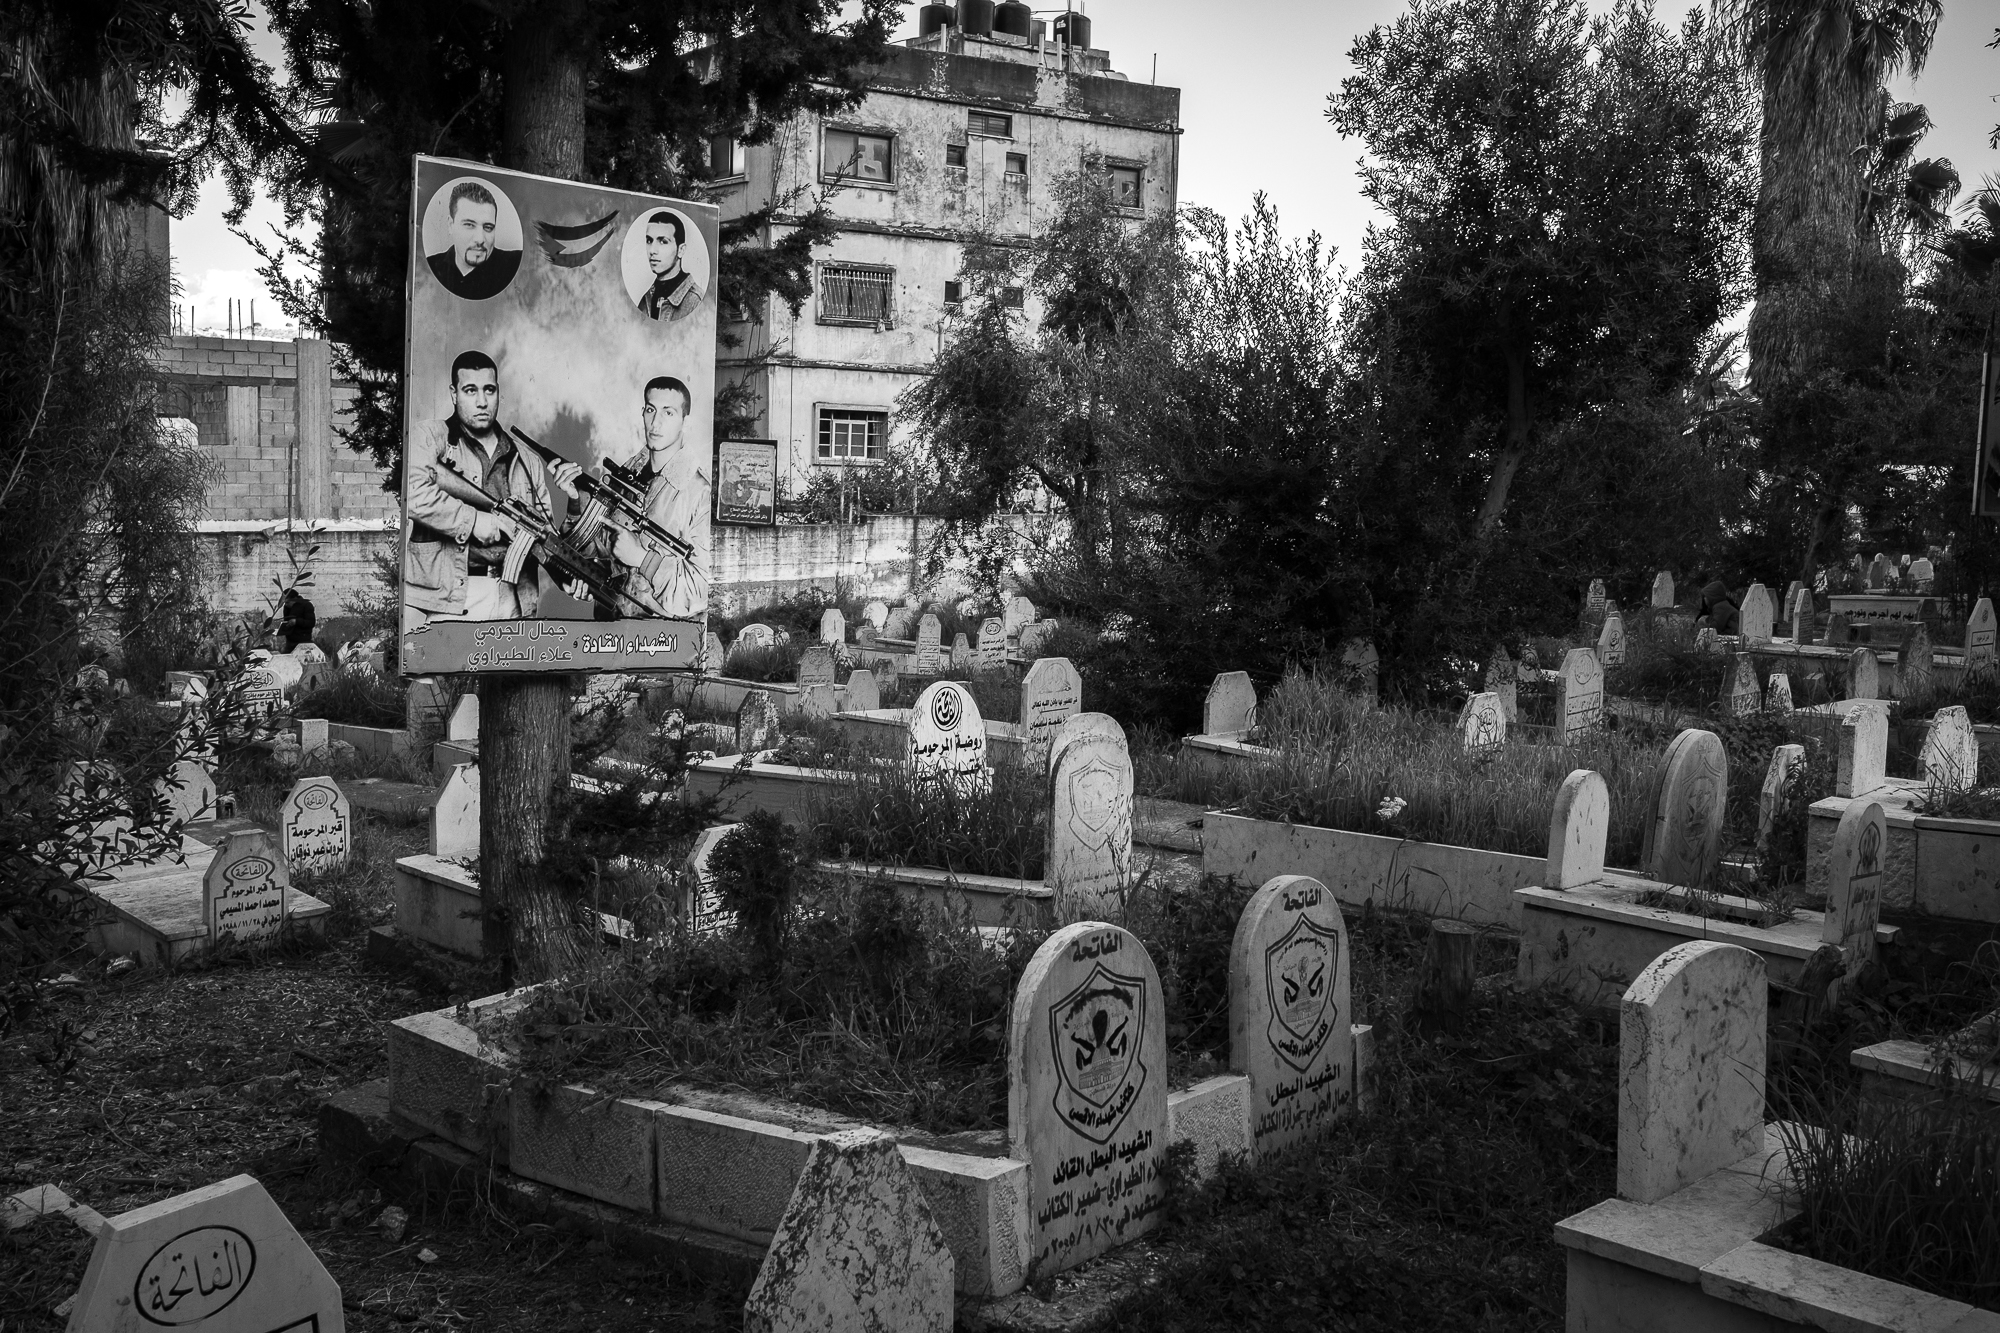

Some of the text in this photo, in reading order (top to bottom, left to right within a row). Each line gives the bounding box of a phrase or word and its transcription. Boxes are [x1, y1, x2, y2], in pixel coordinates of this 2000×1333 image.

[474, 621, 568, 647] جمال الجرمي
[581, 633, 625, 654] القادة
[625, 632, 678, 657] الشهداء
[468, 646, 573, 672] علاء الطيراوي
[291, 820, 343, 839] قبر المرحومة
[311, 845, 326, 860] عمر
[235, 863, 264, 878] الفاتحة
[231, 883, 268, 898] قبر المرحوم
[1282, 888, 1322, 912] الفاتحة
[263, 899, 280, 909] محمد
[261, 915, 268, 929] في
[269, 913, 281, 928] توفي
[1071, 931, 1123, 963] الفاتحة
[1270, 1063, 1340, 1107] الشهيد البطل
[1306, 1092, 1332, 1129] الجرمي
[1332, 1088, 1350, 1114] جمال
[1254, 1110, 1281, 1146] الكتائب
[1053, 1129, 1152, 1186] الشهيد البطل القائد
[1146, 1155, 1165, 1185] علاء
[1038, 1190, 1073, 1232] الكتائب
[1131, 1189, 1168, 1222] ستشهد
[1115, 1205, 1131, 1236] في
[149, 1239, 242, 1312] الفاتحة
